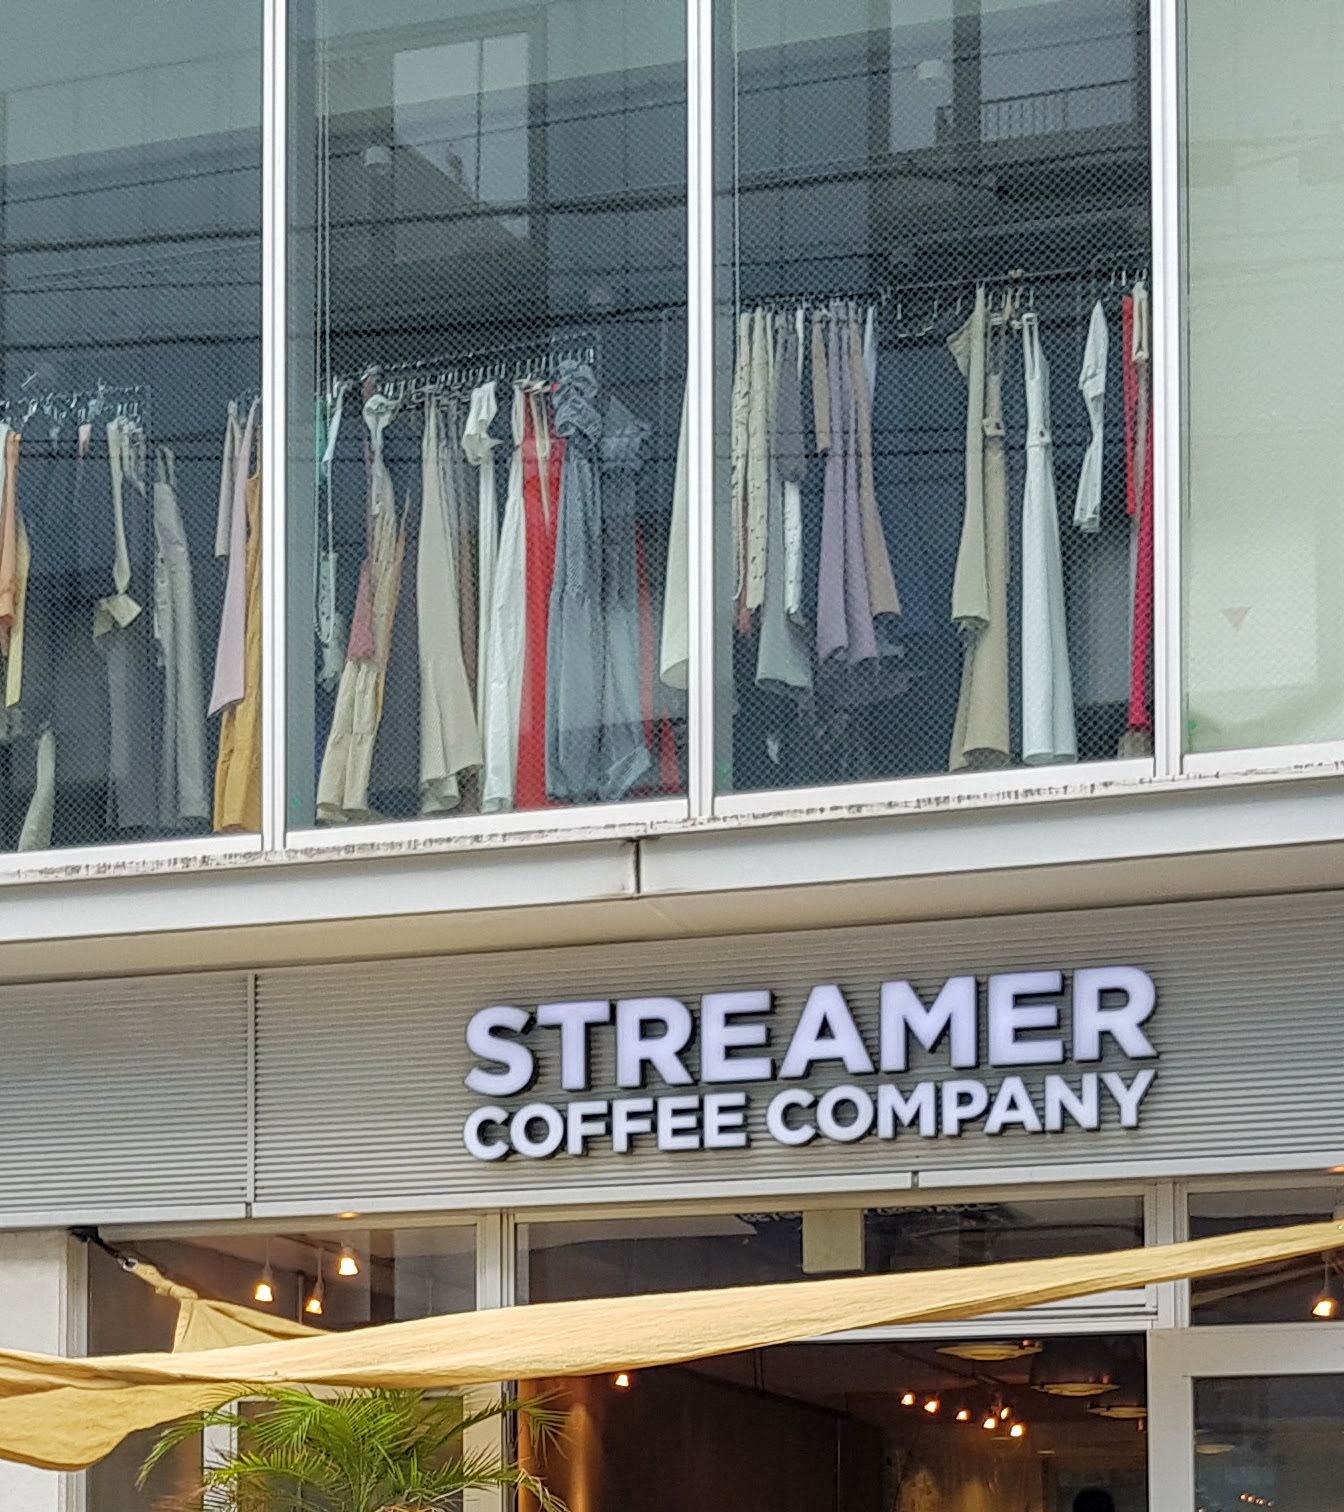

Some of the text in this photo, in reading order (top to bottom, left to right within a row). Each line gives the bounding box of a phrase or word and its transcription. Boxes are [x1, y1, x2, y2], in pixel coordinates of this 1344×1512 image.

[463, 965, 1158, 1096] STREAMER
[463, 1069, 1154, 1161] COFFEE COMPANY
